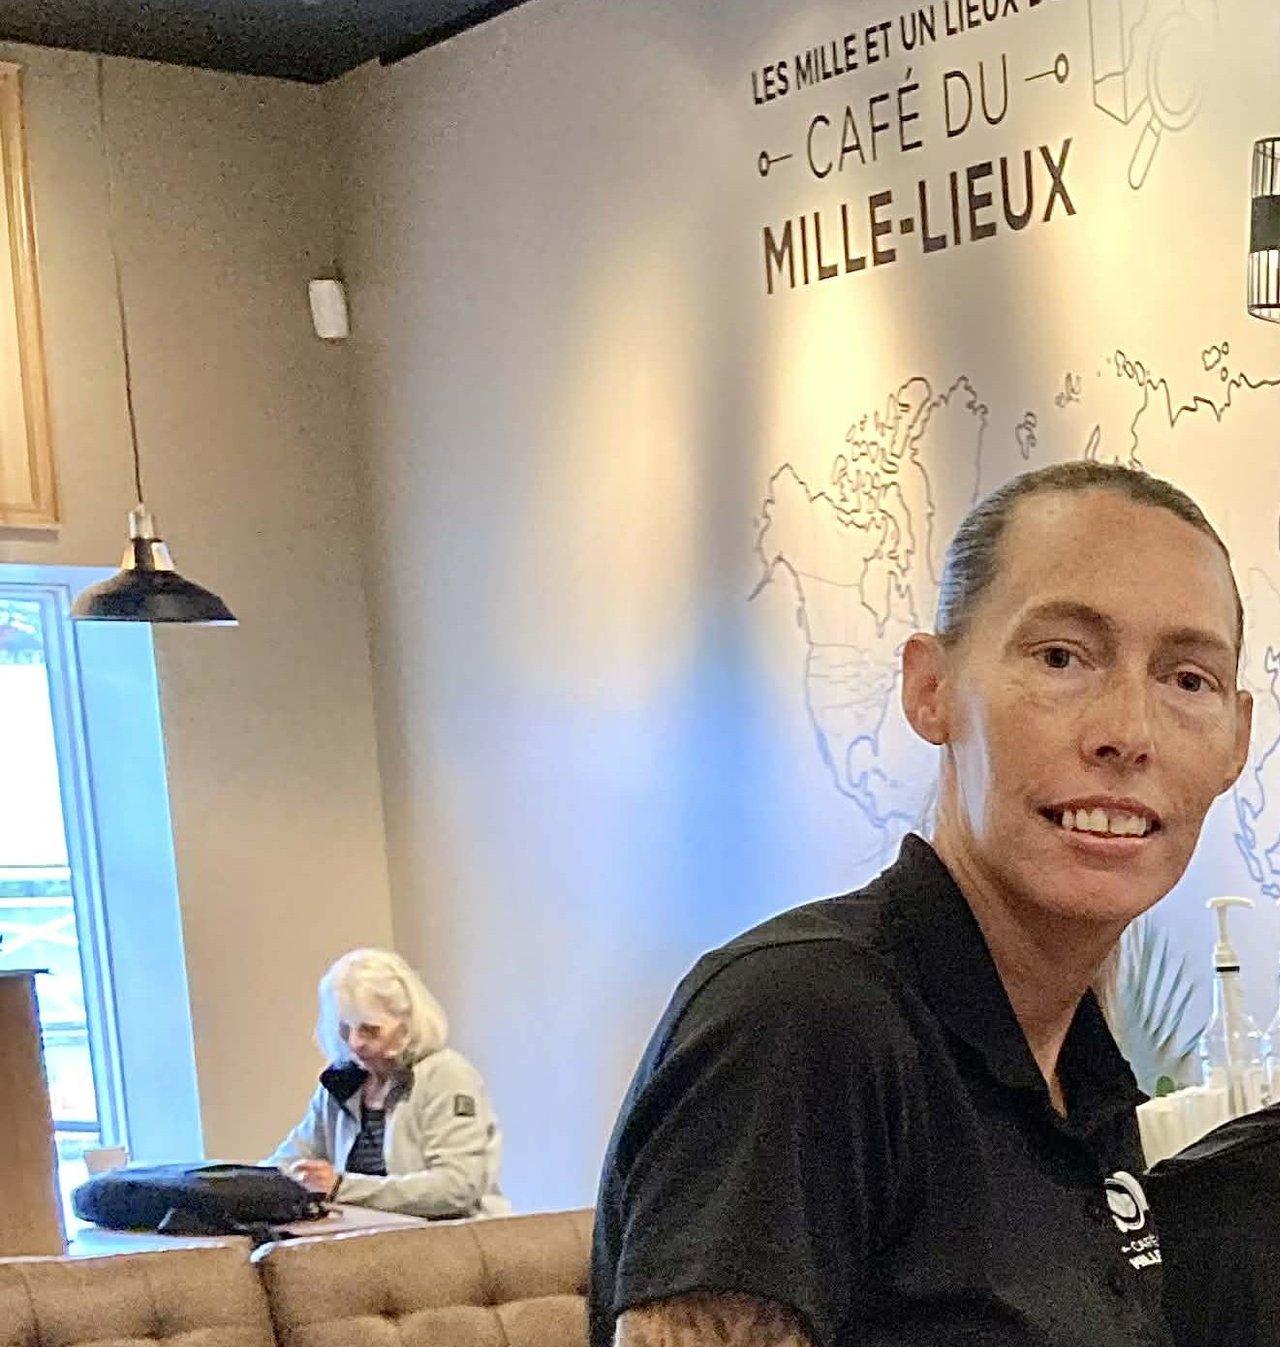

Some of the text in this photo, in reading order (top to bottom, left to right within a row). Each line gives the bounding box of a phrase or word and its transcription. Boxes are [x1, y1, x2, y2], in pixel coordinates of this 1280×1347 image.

[751, 60, 788, 105] LES
[795, 33, 859, 92] MILLE
[864, 20, 893, 66] ET
[900, 5, 936, 51] UN
[806, 52, 1009, 179] CAFÉ DU
[762, 137, 1077, 295] MILLE-LIEUX
